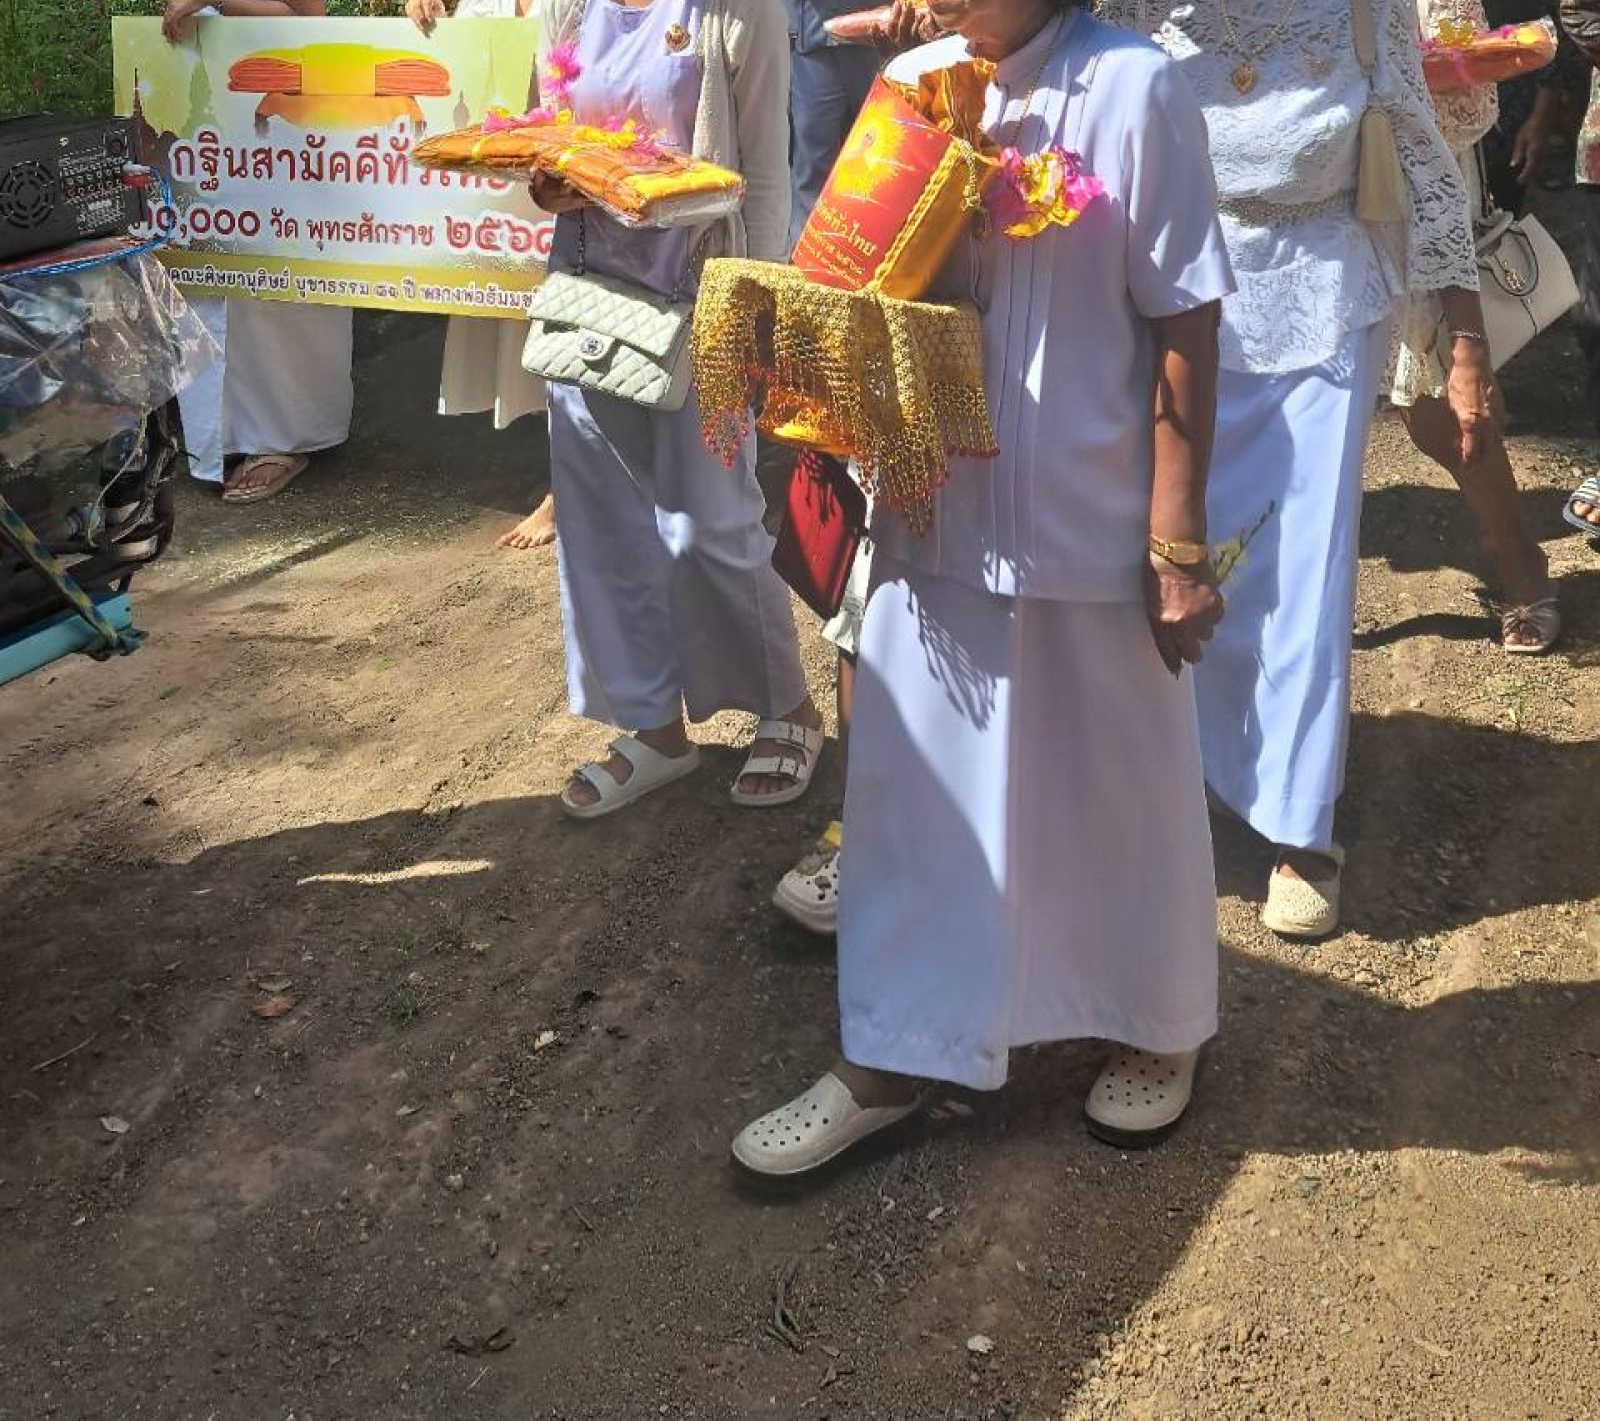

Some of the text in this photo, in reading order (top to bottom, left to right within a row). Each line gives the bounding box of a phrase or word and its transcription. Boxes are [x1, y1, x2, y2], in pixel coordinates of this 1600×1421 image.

[270, 207, 298, 238] วัด
[306, 212, 433, 251] พุทธศักราช
[168, 266, 289, 293] คณะศิษยานุศิษย์
[295, 276, 369, 297] บูชาธรรม
[403, 278, 415, 297] ปี
[419, 282, 540, 308] หลวงพ่อธัมมช
